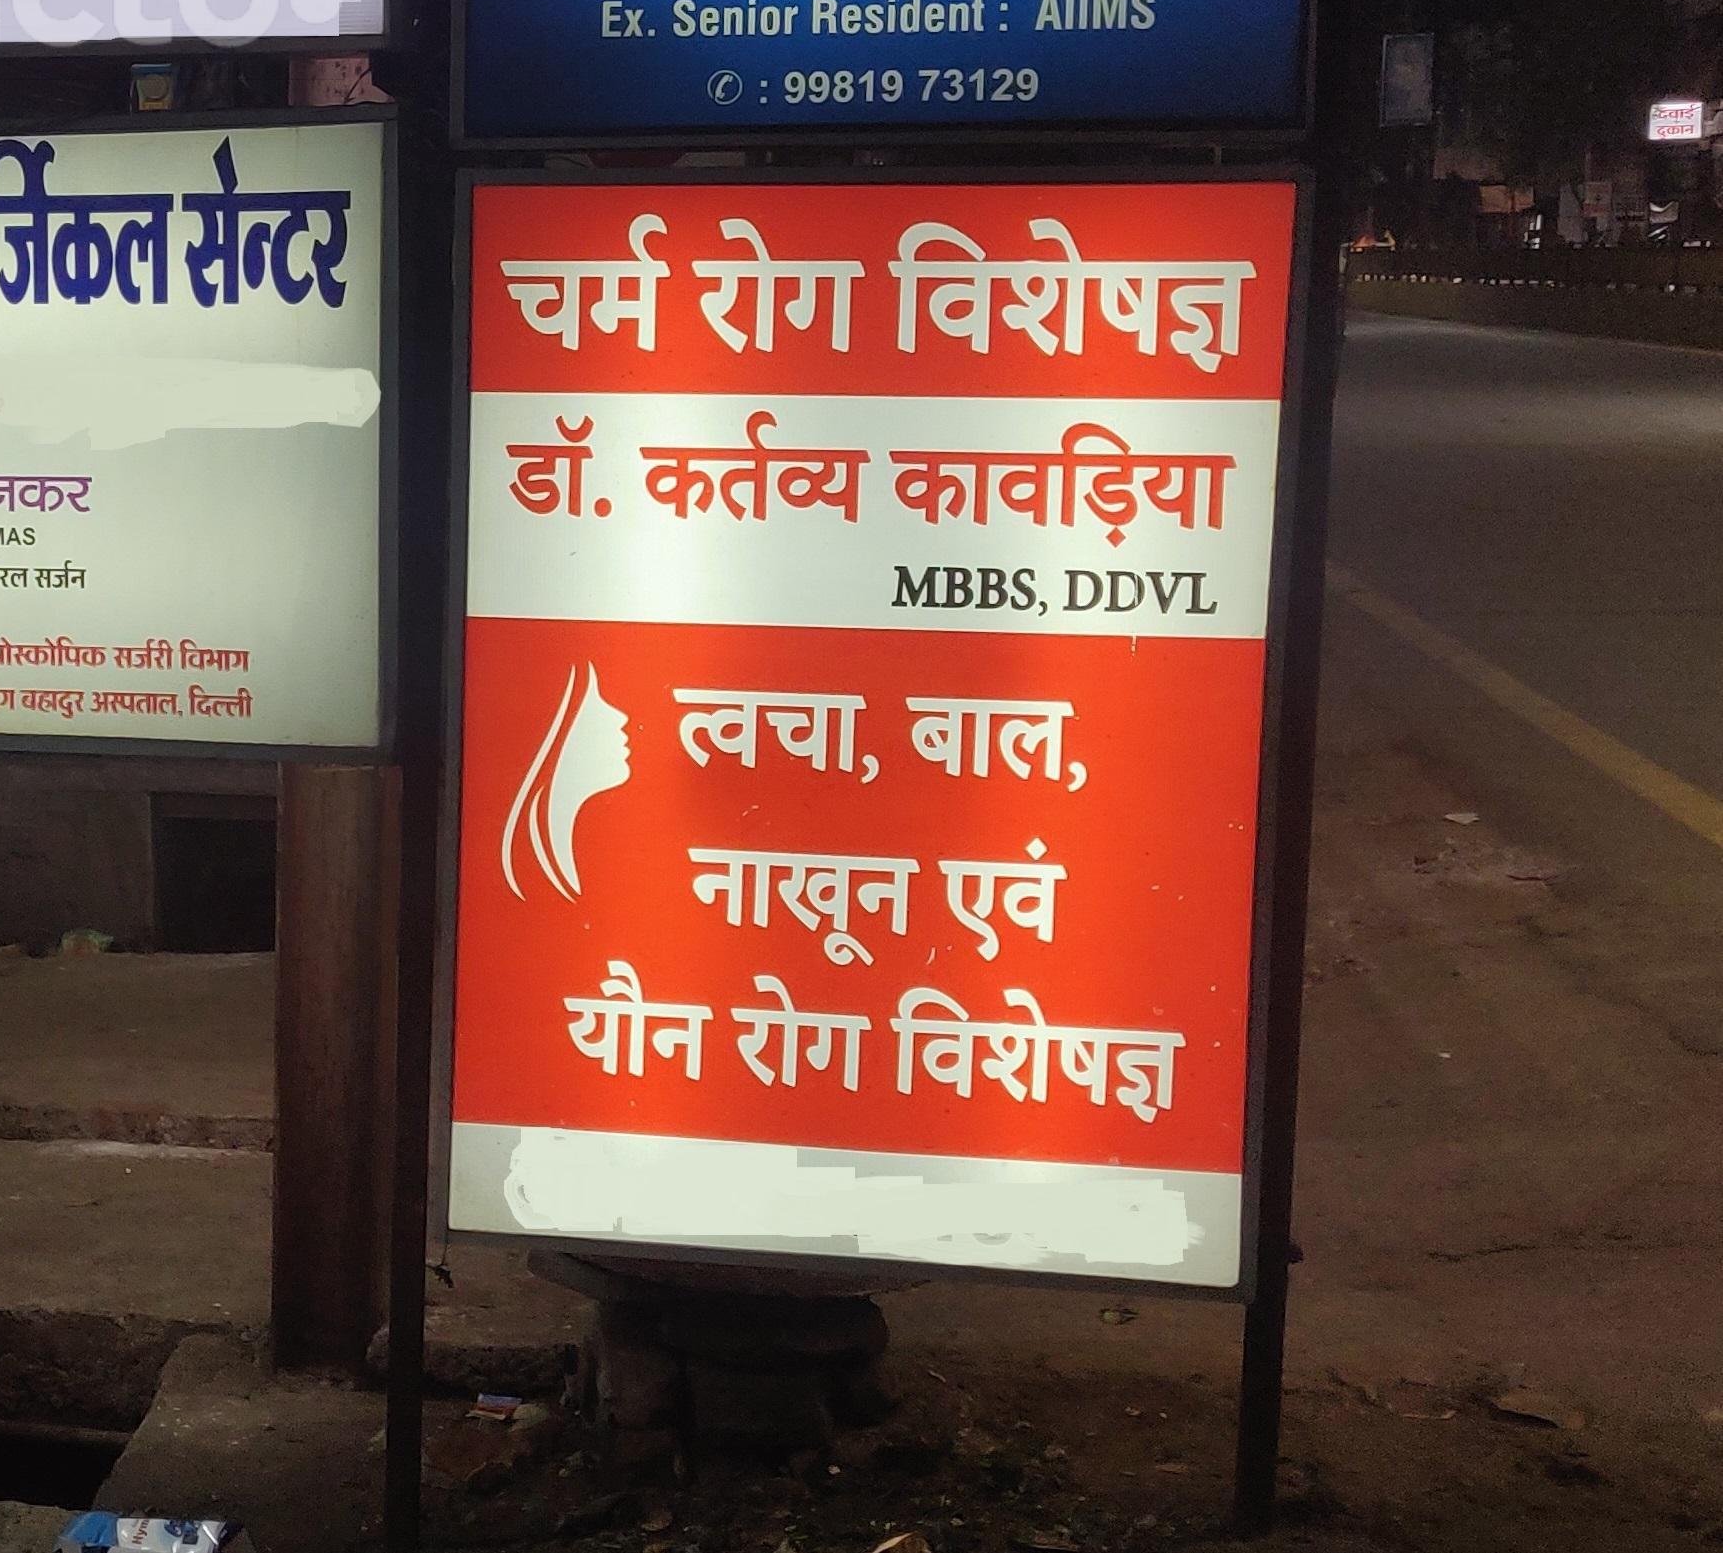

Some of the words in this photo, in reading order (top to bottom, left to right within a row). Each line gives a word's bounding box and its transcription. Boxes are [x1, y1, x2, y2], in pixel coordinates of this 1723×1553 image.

[601, 0, 656, 38] Ex.
[784, 69, 904, 104] 99819
[918, 68, 1039, 102] 73129
[181, 135, 352, 309] सेन्टर
[499, 213, 671, 352] चर्म
[691, 218, 866, 354] रोग
[887, 218, 1257, 373] विशेषज्ञ
[505, 415, 612, 518] डॉ.
[639, 410, 872, 524] कर्तव्य
[888, 422, 1237, 548] कावड़िया
[33, 559, 87, 589] सर्जन
[891, 565, 1048, 617] MBBS,
[1062, 569, 1218, 615] DDVL
[112, 638, 174, 670] सर्जरी
[179, 638, 250, 673] विभाग
[19, 689, 85, 719] बहादुर
[188, 684, 254, 718] दिल्ली
[672, 688, 880, 784] त्वचा,
[905, 696, 1088, 792] बाल,
[687, 847, 921, 966] नाखून
[937, 837, 1068, 961] एवं
[563, 960, 714, 1081] यौन
[730, 974, 872, 1092] रोग
[889, 986, 1186, 1123] विशेषज्ञ
